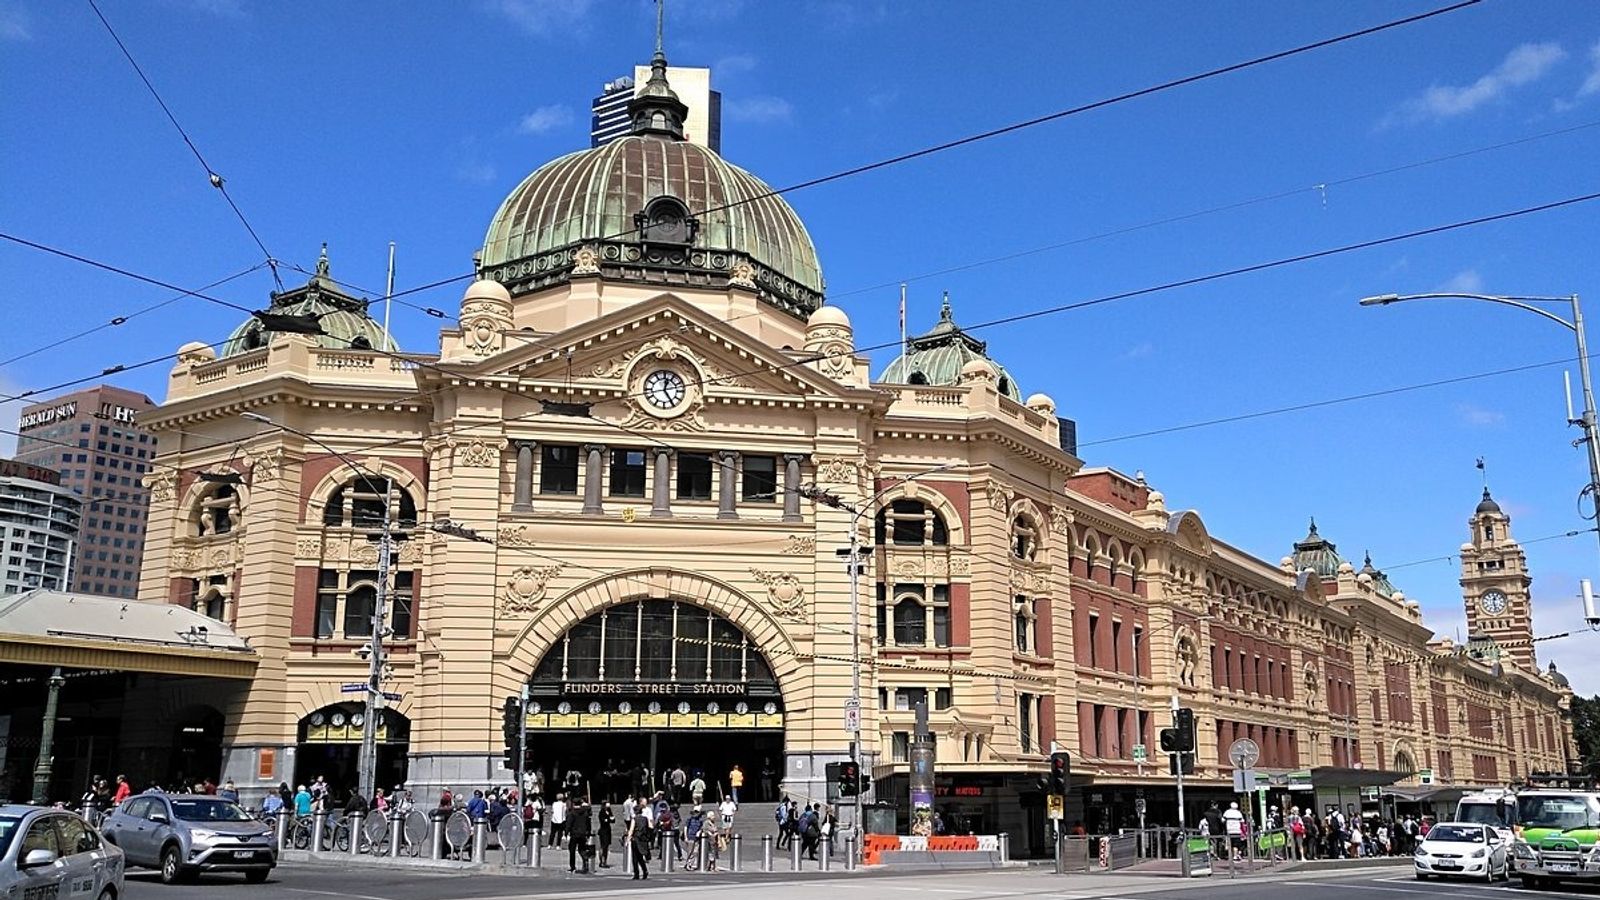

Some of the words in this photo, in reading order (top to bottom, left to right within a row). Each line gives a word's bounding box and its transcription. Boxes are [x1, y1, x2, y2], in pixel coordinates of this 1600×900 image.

[18, 409, 54, 427] HERALD
[56, 402, 76, 417] SUN
[564, 684, 622, 694] FLINDERS
[636, 684, 680, 694] STREET
[693, 684, 744, 694] STATION
